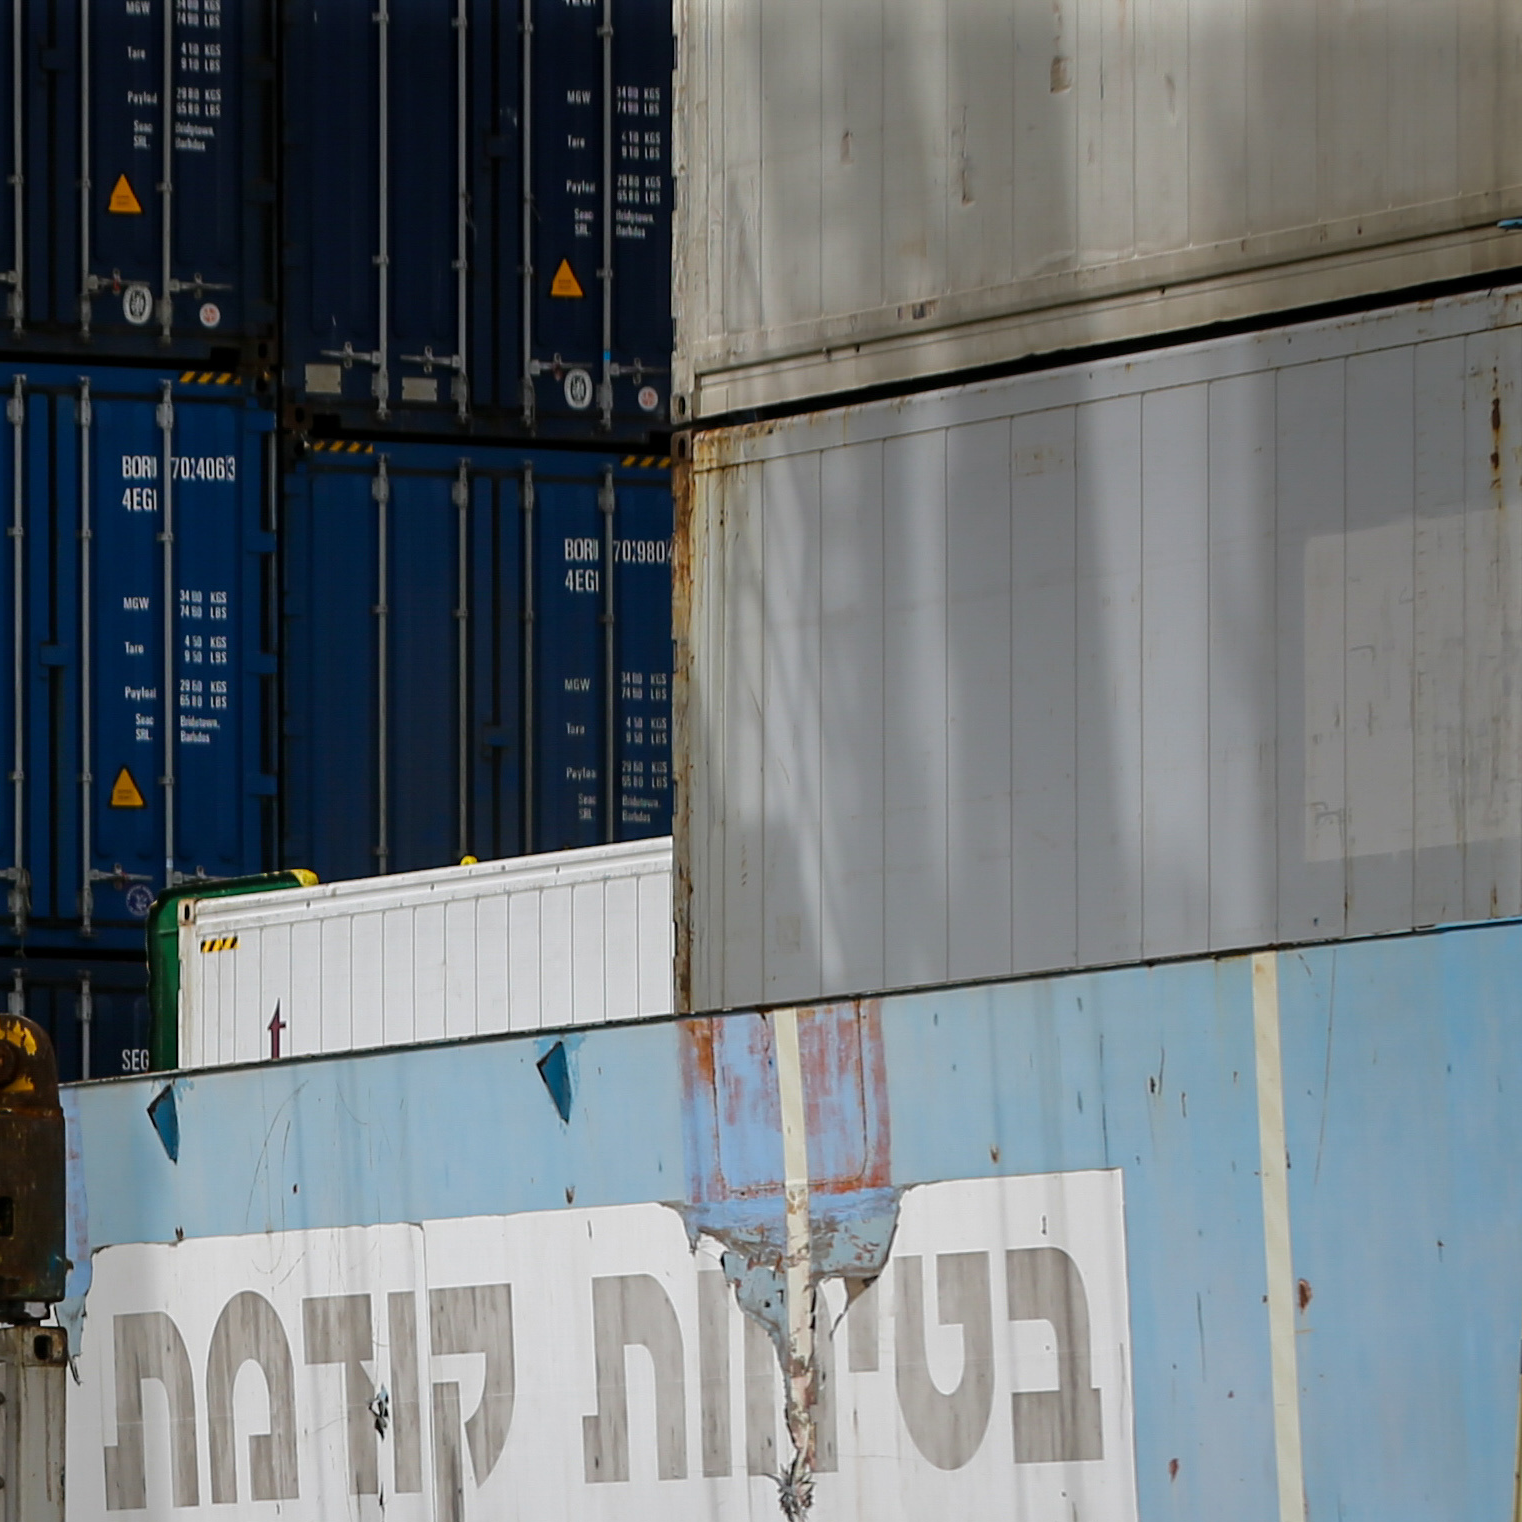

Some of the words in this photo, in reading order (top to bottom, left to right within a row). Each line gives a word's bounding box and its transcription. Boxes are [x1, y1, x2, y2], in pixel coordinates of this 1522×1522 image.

[123, 597, 149, 610] MGW
[210, 592, 227, 604] KGS
[210, 607, 227, 618] LBS
[125, 642, 144, 655] Tare
[210, 636, 227, 648] KGS
[210, 652, 227, 664] LBS
[210, 681, 227, 693] KGS
[210, 696, 227, 708] LBS
